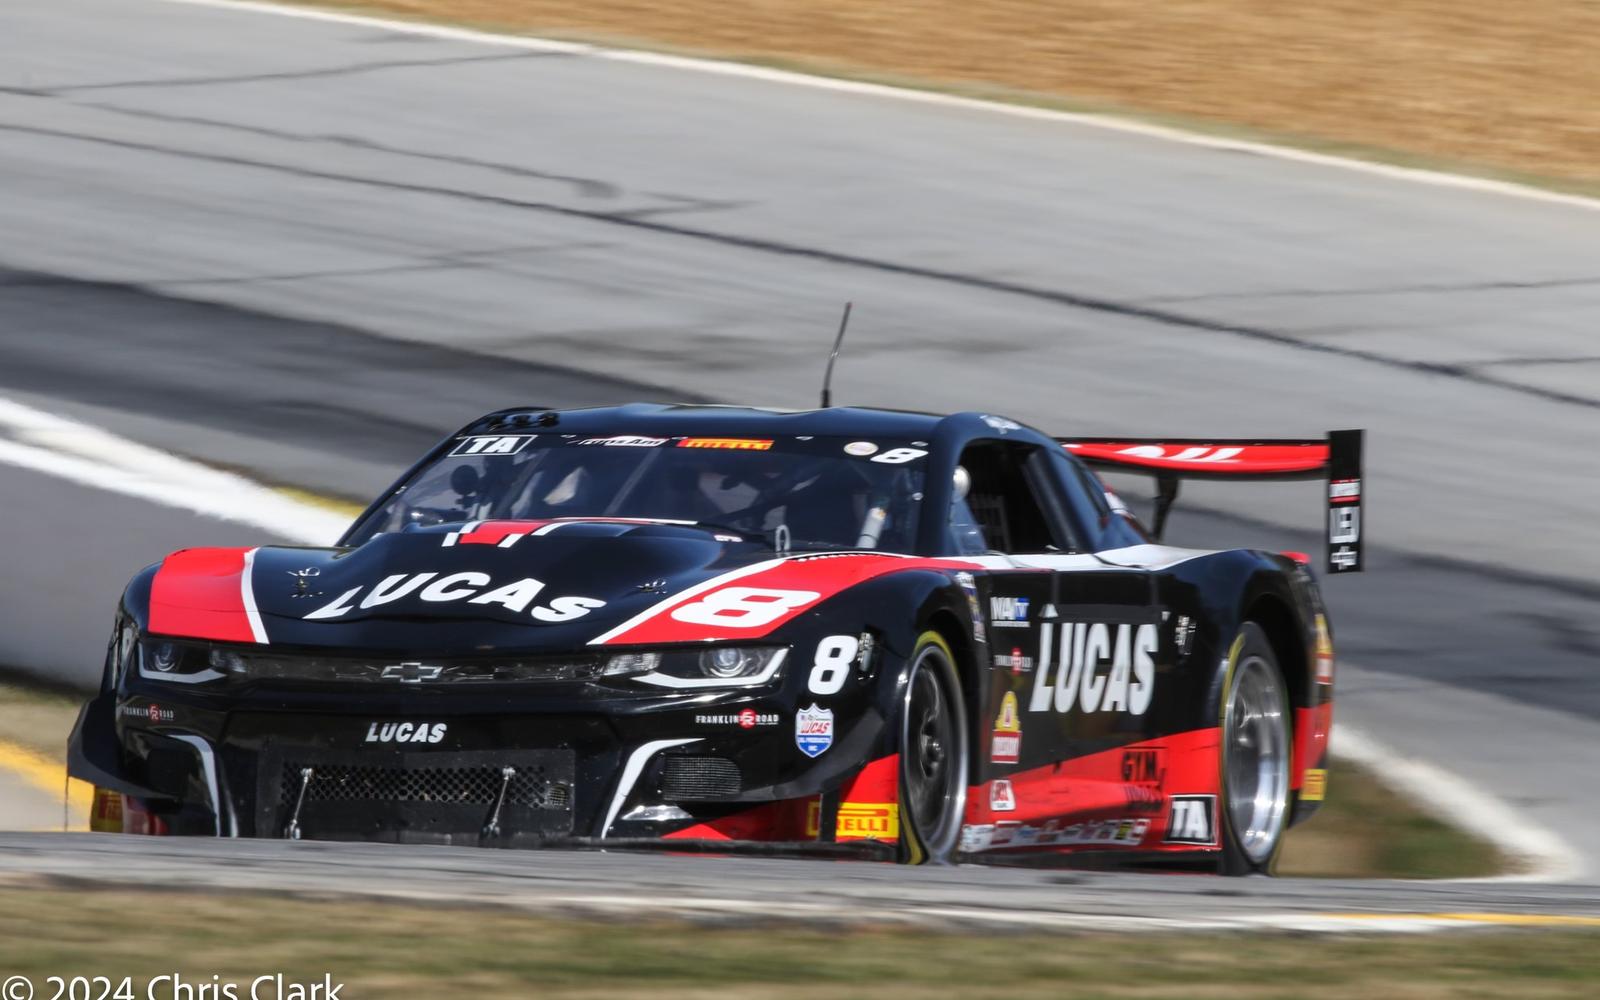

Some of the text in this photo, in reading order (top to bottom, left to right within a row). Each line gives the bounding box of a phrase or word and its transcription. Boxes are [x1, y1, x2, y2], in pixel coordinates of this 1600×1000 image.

[468, 435, 521, 454] TA
[871, 447, 926, 464] 8
[304, 569, 606, 622] LUCAS
[670, 587, 820, 628] 8
[807, 635, 858, 695] 8
[1028, 621, 1160, 716] LUCAS
[122, 706, 149, 717] RANKLIN
[695, 714, 740, 724] FRANKLIN
[755, 714, 779, 723] ROAD
[365, 722, 447, 744] LUCAS
[1169, 799, 1211, 842] TA
